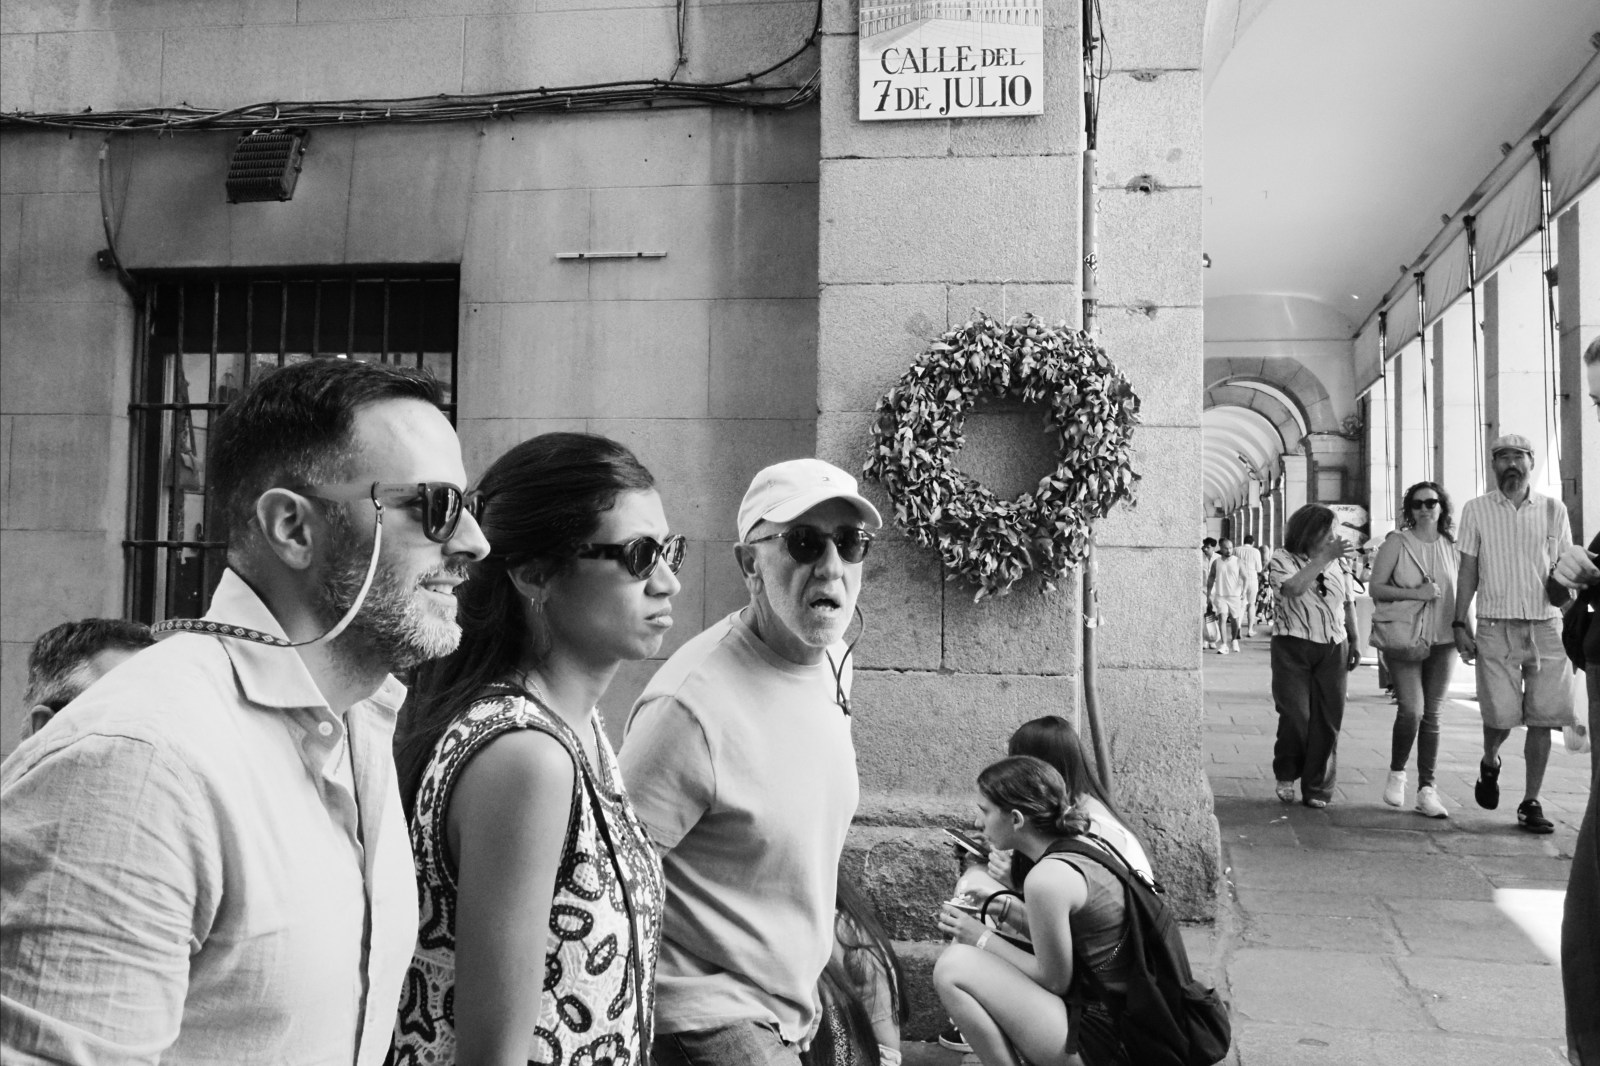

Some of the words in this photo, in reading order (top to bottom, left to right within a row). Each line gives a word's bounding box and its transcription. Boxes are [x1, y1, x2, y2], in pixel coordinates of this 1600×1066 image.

[881, 46, 977, 75] CALLE
[980, 48, 1026, 67] DEL
[873, 80, 892, 112] 7
[894, 87, 932, 111] DE
[939, 75, 1032, 115] JULIO
